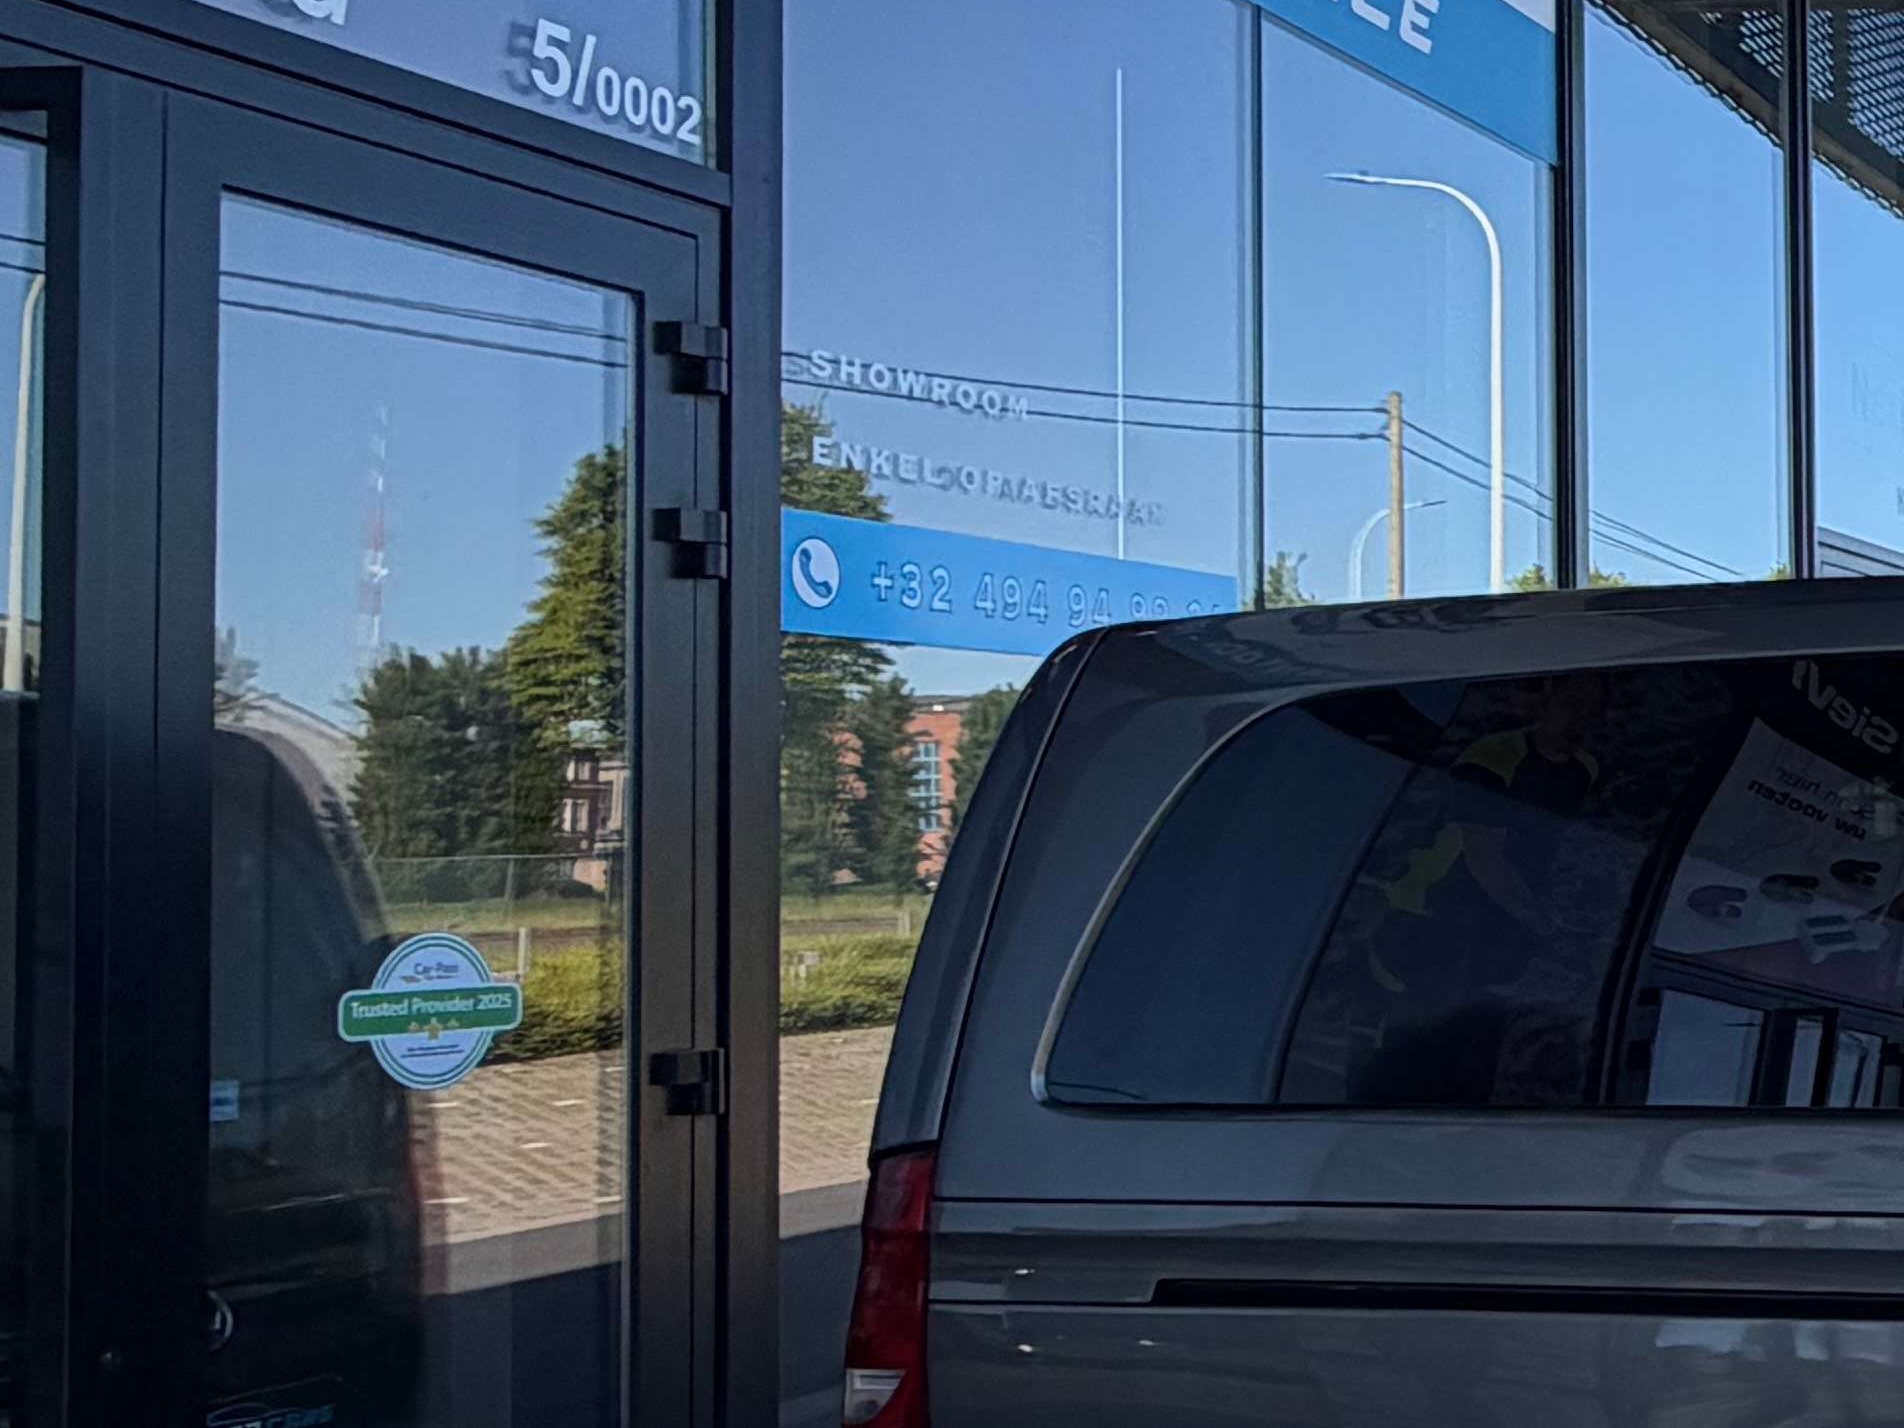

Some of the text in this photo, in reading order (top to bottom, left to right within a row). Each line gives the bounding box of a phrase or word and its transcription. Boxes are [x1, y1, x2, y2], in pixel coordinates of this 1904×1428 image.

[529, 17, 703, 146] 5/0002
[809, 350, 1029, 420] SHOWROOM
[812, 436, 944, 486] ENKEL
[871, 560, 953, 614] +32
[974, 573, 1049, 625] 494
[1067, 584, 1112, 628] 94
[351, 999, 408, 1019] Trusted
[411, 997, 475, 1014] Provider
